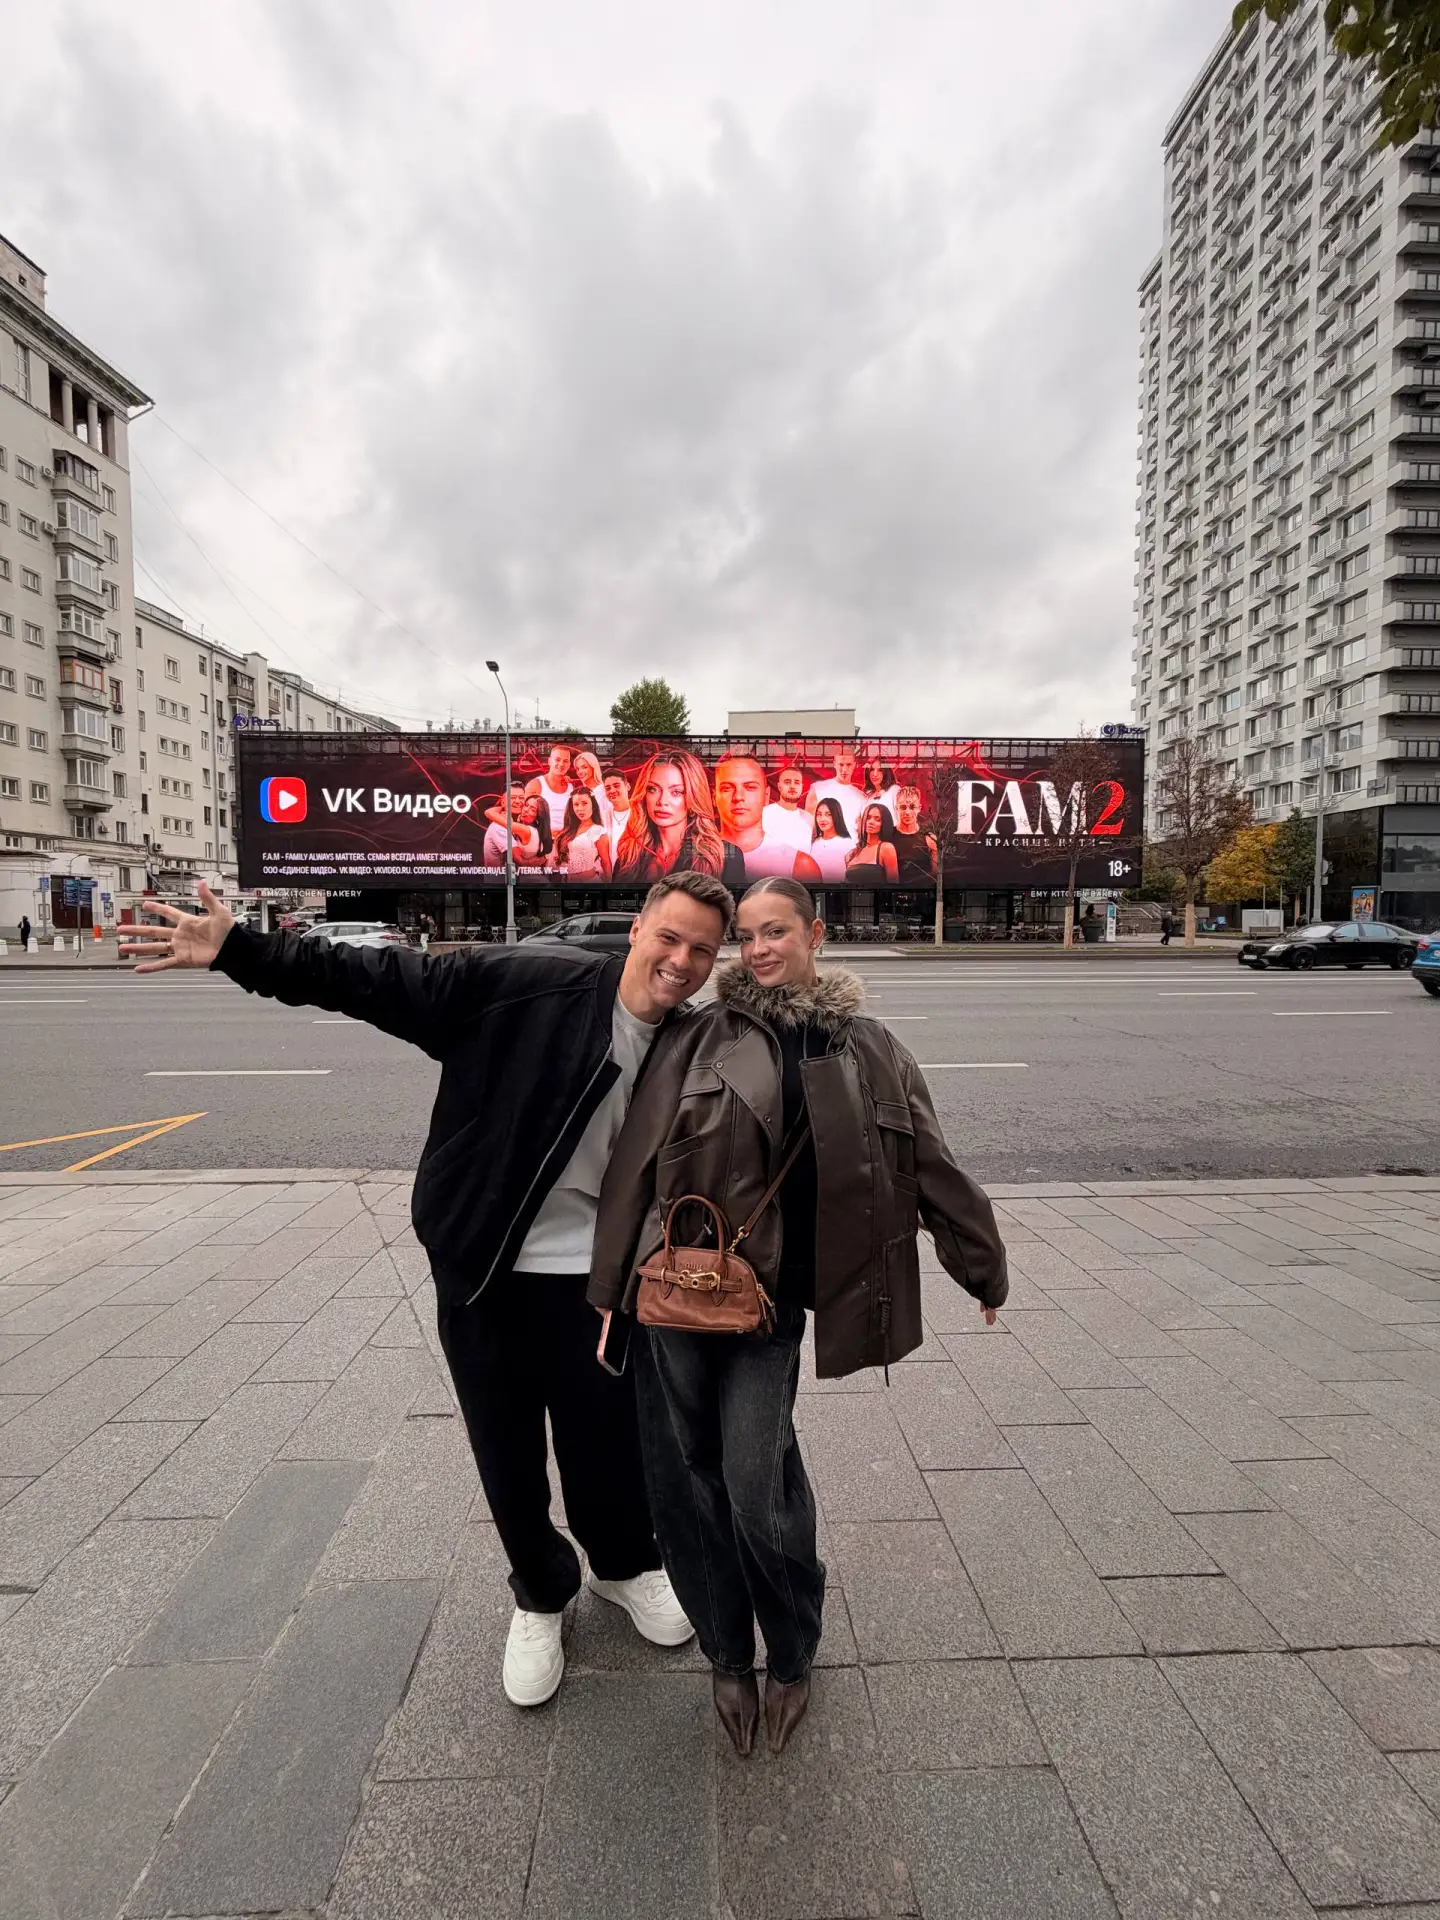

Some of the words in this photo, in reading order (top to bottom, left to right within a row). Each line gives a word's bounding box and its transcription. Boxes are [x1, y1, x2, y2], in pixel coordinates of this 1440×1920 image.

[321, 788, 366, 813] VK
[373, 788, 472, 818] Видео
[262, 853, 280, 861] F.A.M
[285, 853, 307, 861] FAMILY
[308, 853, 334, 861] ALWAYS
[335, 853, 366, 861] MATTERS.
[367, 853, 390, 861] СЕМЬЯ
[391, 853, 416, 862] ВСЕГДА
[416, 853, 439, 862] ИМЕЕТ
[439, 853, 473, 862] ЗНАЧЕНИЕ
[262, 866, 278, 874] ООО
[279, 866, 309, 876] «ЕДИНОЕ
[339, 866, 348, 874] VK
[349, 866, 372, 875] ВИДЕО:
[413, 866, 459, 875] СОГЛАШЕНИЕ:
[459, 866, 543, 876] VKVIDEO.RU/LE/TERMS.
[1108, 860, 1131, 877] 18+
[284, 890, 322, 898] KITCHEN
[326, 890, 362, 898] BAKERY
[1051, 890, 1087, 898] KITCEN
[1090, 890, 1123, 898] BAKERY
